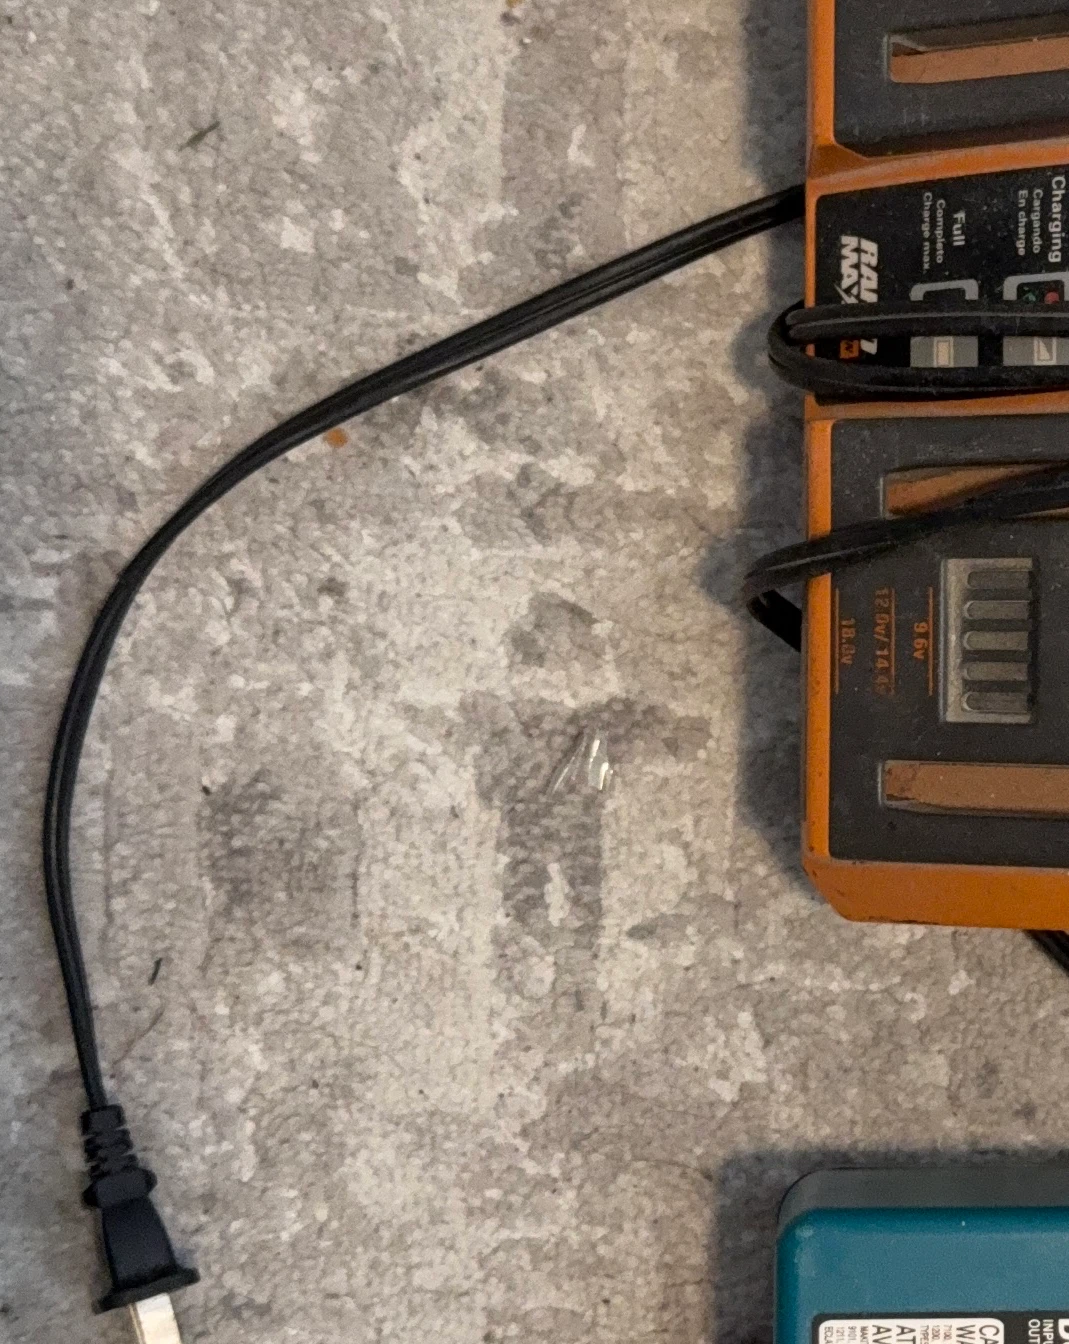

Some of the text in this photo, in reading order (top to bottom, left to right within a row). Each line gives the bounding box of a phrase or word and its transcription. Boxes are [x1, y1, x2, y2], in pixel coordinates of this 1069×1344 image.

[922, 192, 932, 238] Charge
[934, 199, 946, 264] Completo
[952, 212, 966, 246] Full
[1016, 190, 1028, 256] En charge
[1031, 189, 1043, 254] Cargando
[1048, 176, 1066, 262] Charging
